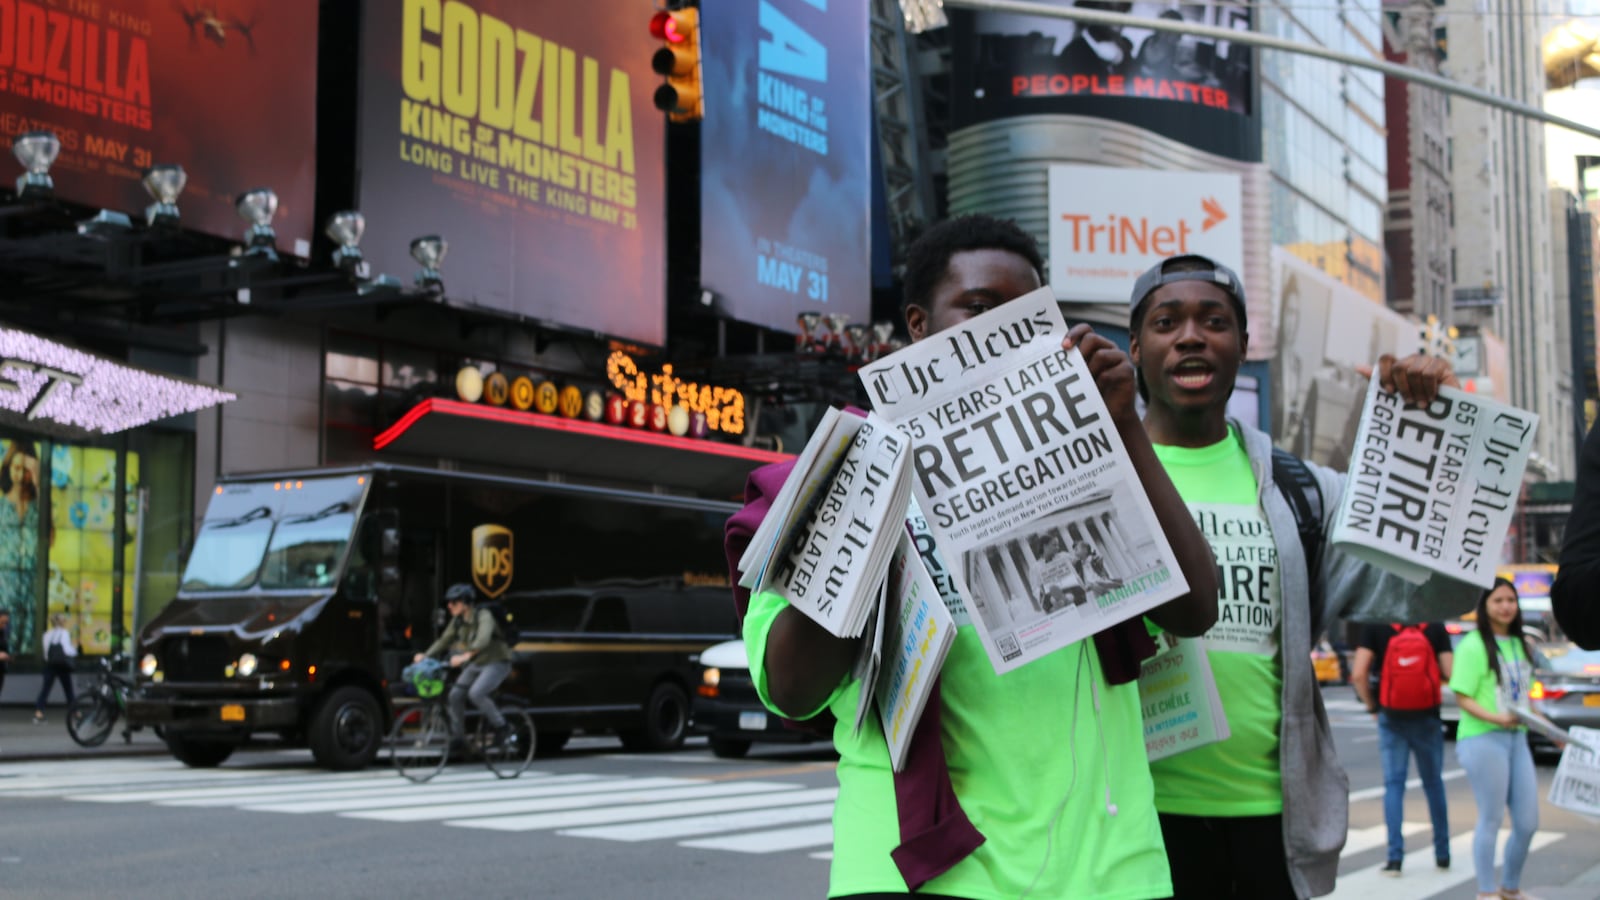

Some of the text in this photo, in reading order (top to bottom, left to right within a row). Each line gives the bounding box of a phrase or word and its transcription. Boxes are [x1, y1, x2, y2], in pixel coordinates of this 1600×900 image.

[108, 9, 152, 35] KING
[32, 78, 152, 131] MONSTERS
[401, 0, 635, 175] GODZILLA
[757, 70, 809, 123] KING
[1012, 74, 1229, 109] PEOPLE MATTER
[84, 133, 129, 162] MAY
[400, 98, 471, 154] KING
[499, 133, 637, 209] MONSTERS
[400, 140, 453, 174] LONG
[460, 159, 499, 189] LIVE
[506, 174, 539, 202] THE
[546, 187, 588, 216] KING
[589, 200, 619, 228] MAY
[1061, 213, 1191, 256] TriNet
[757, 254, 828, 302] MAY 31
[868, 309, 1054, 406] The News
[928, 384, 1002, 428] YEARS
[1004, 350, 1073, 396] LATER
[613, 398, 622, 421] 1
[633, 402, 646, 426] 2
[654, 405, 666, 429] 3
[855, 423, 874, 450] 65
[913, 373, 1100, 498] RETIRE
[820, 457, 860, 527] YEARS
[860, 434, 903, 507] The
[932, 427, 1114, 529] SEGREGATION
[1346, 386, 1398, 533] EGREGATION
[1376, 395, 1453, 552] RETIRE
[1421, 400, 1478, 560] 65 YEARS LATER
[1457, 411, 1532, 574] The News
[969, 515, 997, 531] leaders
[997, 503, 1025, 520] demand
[1024, 493, 1048, 508] action
[1048, 479, 1077, 496] towards
[1077, 460, 1117, 482] integration
[975, 529, 989, 541] and
[989, 518, 1012, 535] equity
[1012, 515, 1020, 524] in
[1020, 507, 1037, 520] New
[1036, 501, 1053, 513] York
[1054, 493, 1070, 507] City
[475, 546, 512, 587] ups
[791, 530, 828, 598] LATER
[817, 511, 874, 619] News
[1096, 565, 1172, 609] MANHATTAN
[1226, 546, 1277, 565] LATER
